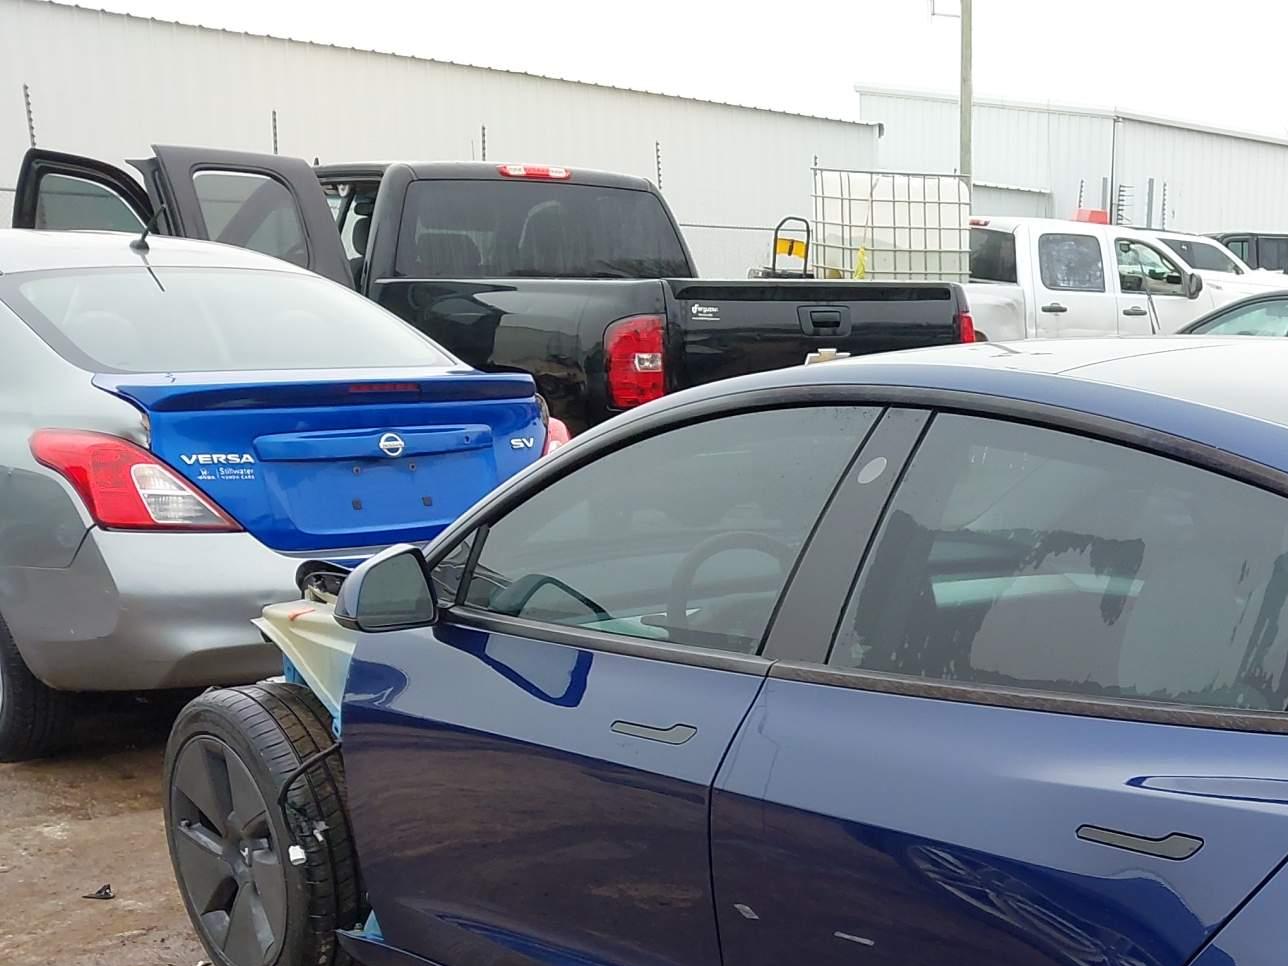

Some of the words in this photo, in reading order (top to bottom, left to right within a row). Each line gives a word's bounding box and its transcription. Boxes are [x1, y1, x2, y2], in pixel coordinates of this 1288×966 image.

[510, 437, 534, 449] SV
[180, 453, 255, 465] VERSA
[218, 467, 254, 475] Stillwater
